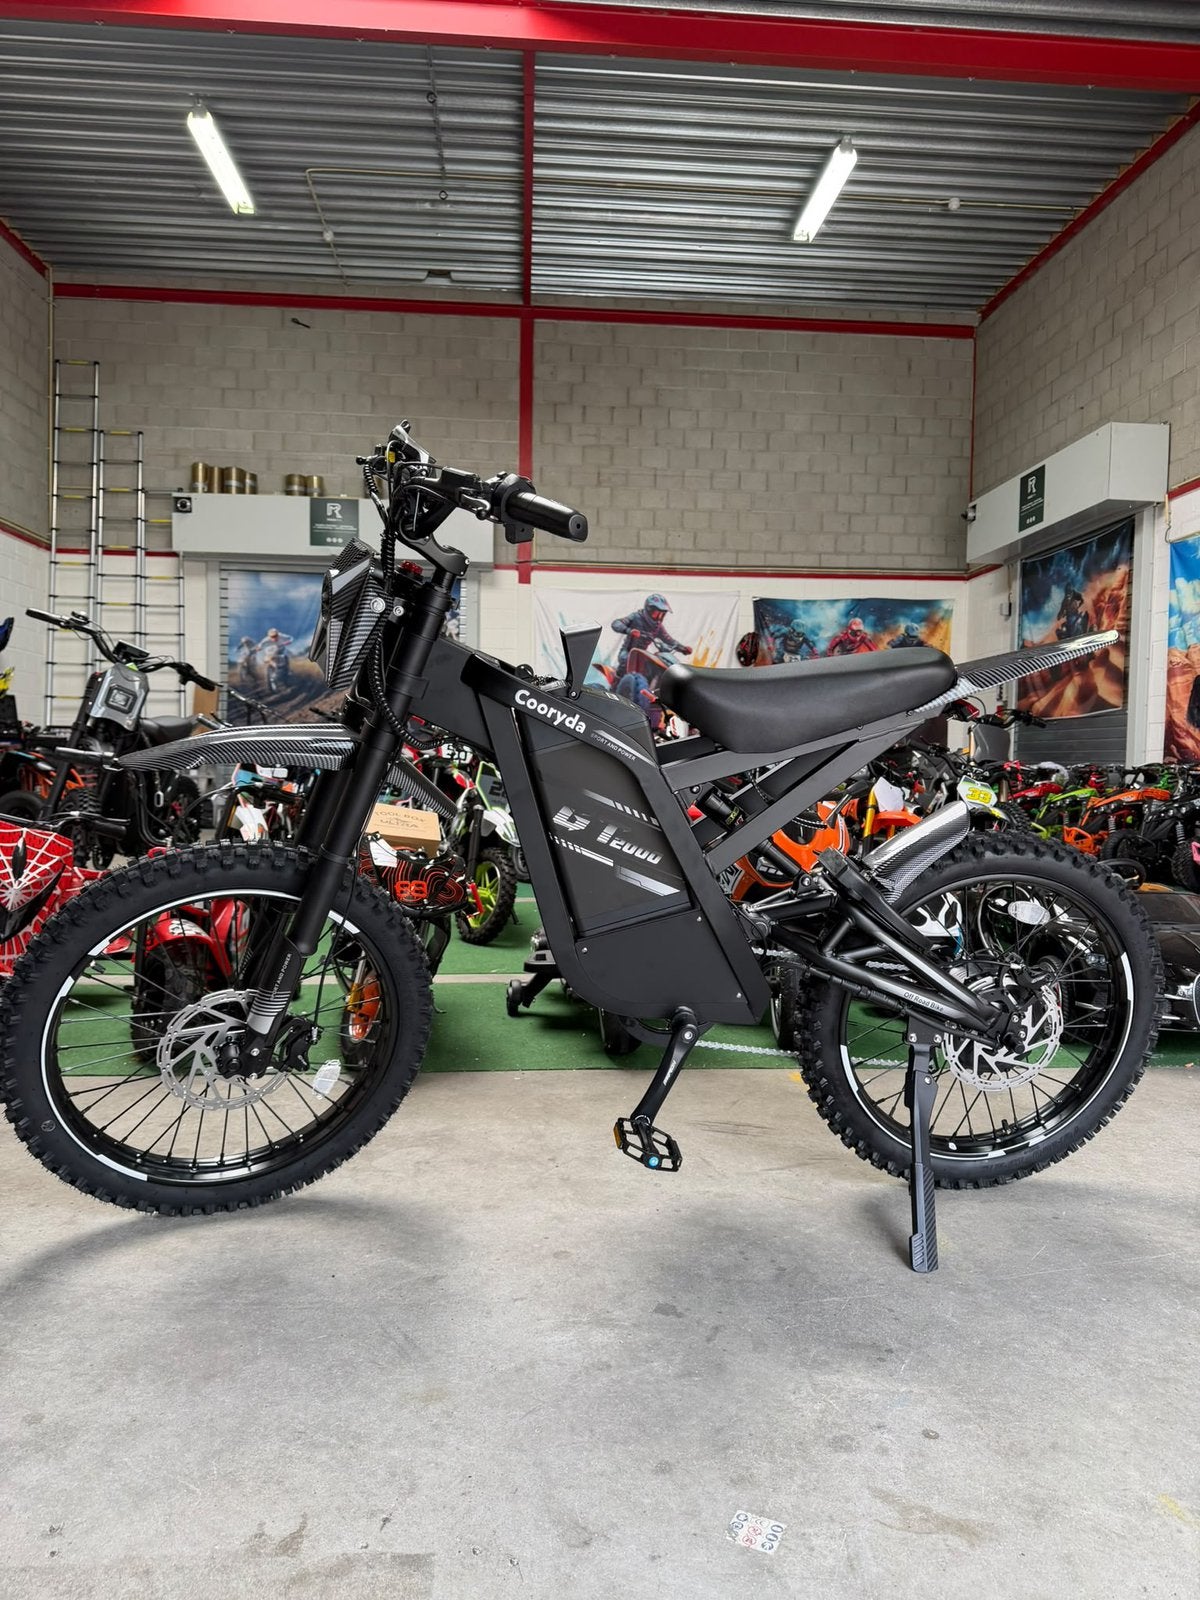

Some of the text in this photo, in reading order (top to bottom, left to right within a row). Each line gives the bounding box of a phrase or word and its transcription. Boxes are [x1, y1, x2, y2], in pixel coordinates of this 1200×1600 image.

[514, 689, 586, 734] Cooryda
[590, 732, 637, 761] SPORT AND POWER
[914, 996, 930, 1006] Road
[930, 1002, 944, 1011] Bike
